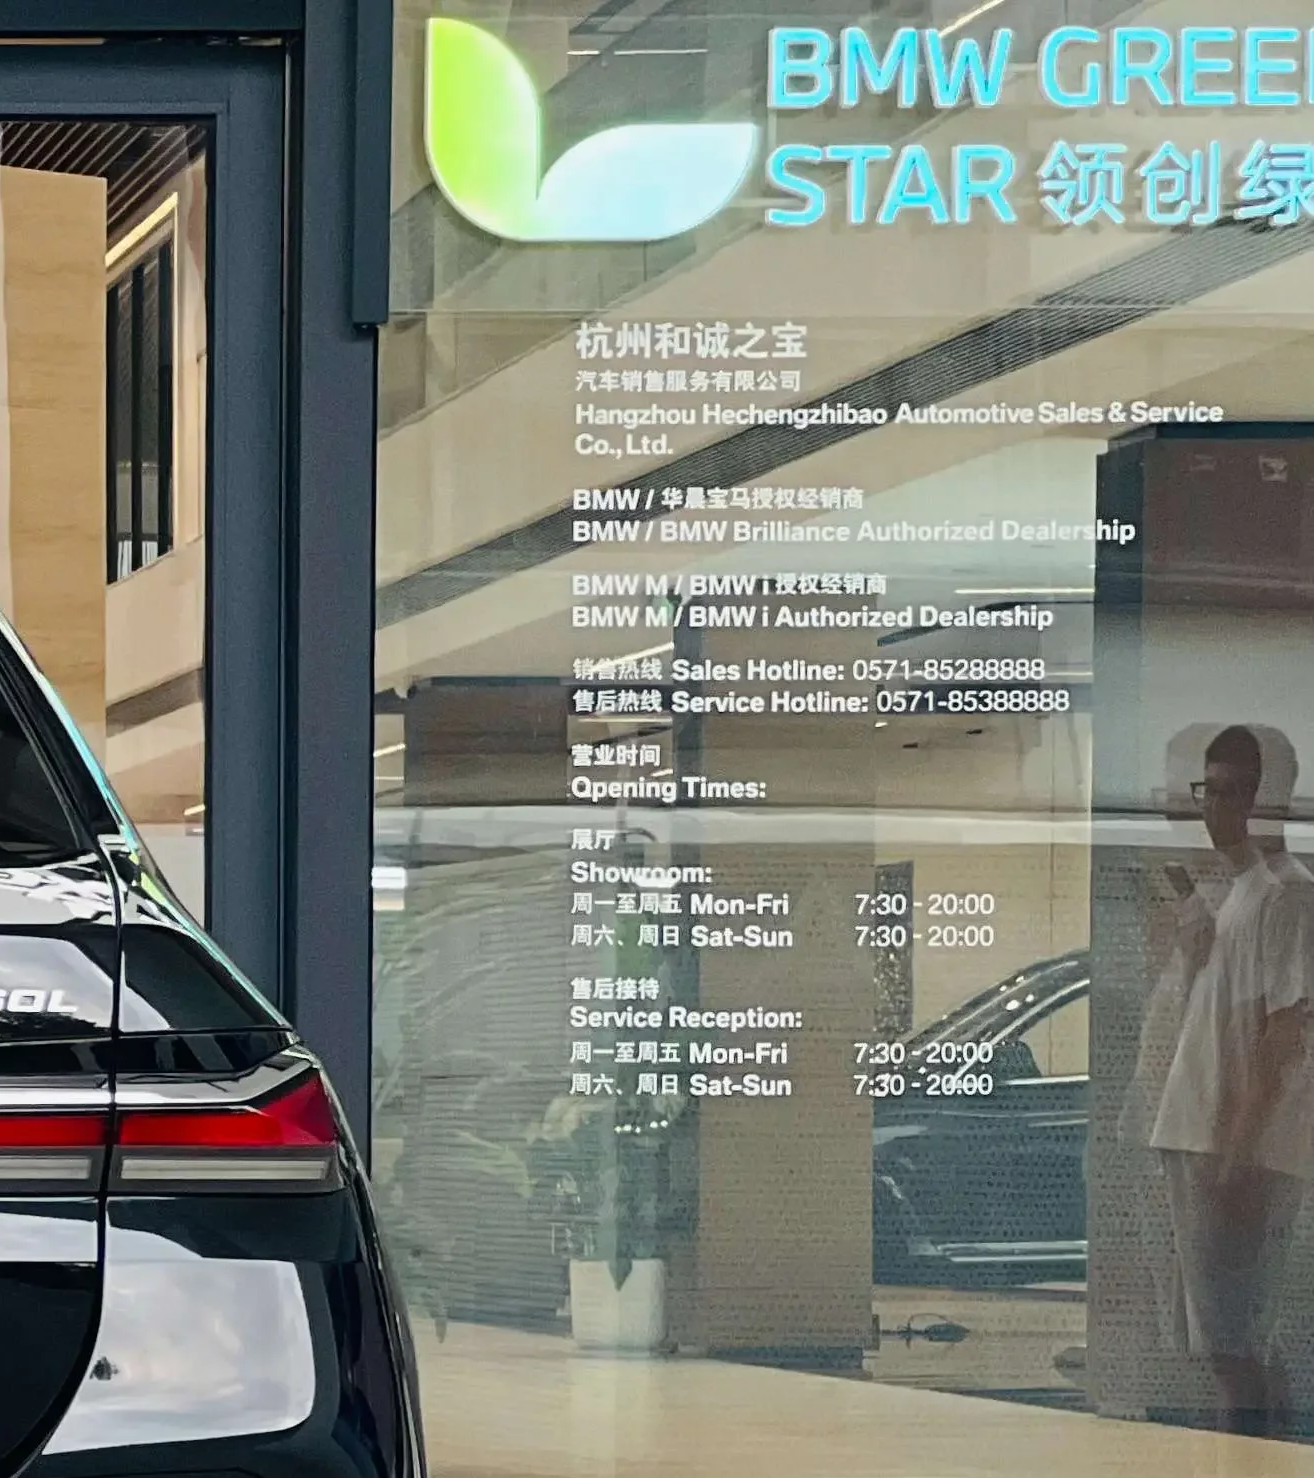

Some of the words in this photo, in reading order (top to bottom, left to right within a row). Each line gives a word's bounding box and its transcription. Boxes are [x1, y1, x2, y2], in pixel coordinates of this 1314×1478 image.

[766, 26, 1012, 108] BMW
[1040, 25, 1314, 108] GREE
[765, 143, 1017, 226] STAR
[1038, 138, 1314, 227] 领创绿
[576, 321, 807, 359] 杭州和诚之宝
[576, 370, 800, 392] 汽车销售服务有限公司
[576, 403, 695, 429] Hangzhou
[703, 403, 888, 429] Hechengzhibao
[895, 402, 1034, 424] Automotive
[1038, 401, 1103, 424] Sales
[1108, 401, 1126, 424] &
[1131, 401, 1223, 424] Service
[573, 489, 640, 510] BMW
[661, 487, 863, 510] 华晨宝马授权经销商
[573, 520, 639, 542] BMW
[660, 520, 727, 542] BMW
[733, 520, 850, 542] Brilliance
[857, 519, 994, 542] Authorized
[1002, 519, 1136, 544] Dealership
[572, 574, 639, 595] BMW
[646, 574, 667, 595] M
[689, 574, 756, 595] BMW
[762, 573, 769, 595] i
[775, 572, 887, 595] 授权经销商
[572, 605, 639, 627] BMW
[645, 605, 667, 627] M
[689, 605, 756, 627] BMW
[762, 605, 769, 627] i
[775, 605, 913, 628] Authorized
[920, 605, 1053, 631] Dealership
[573, 658, 662, 681] 销售热线
[672, 659, 740, 681] Sales
[747, 659, 845, 681] Hotline:
[852, 659, 1045, 681] 0571-85288888
[573, 689, 662, 713] 售后热线
[672, 690, 764, 713] Service
[771, 690, 868, 713] Hotline:
[876, 690, 1070, 713] 0571-85388888
[571, 744, 661, 767] 营业时间
[571, 776, 676, 803] Opening
[681, 776, 767, 798] Times:
[571, 828, 615, 850] 展厅
[571, 861, 712, 883] Showroom:
[571, 893, 682, 914] 周一至周五
[690, 893, 789, 915] Mon-Fri
[855, 893, 907, 915] 7:30
[927, 893, 995, 915] 20:00
[571, 924, 679, 947] 周六、周日
[691, 925, 793, 947] Sat-Sun
[855, 926, 907, 947] 7:30
[927, 926, 995, 947] 20:00
[571, 977, 660, 1000] 售后接待
[570, 1006, 662, 1028] Service
[668, 1006, 802, 1032] Reception:
[570, 1041, 681, 1063] 周一至周五
[689, 1042, 788, 1064] Mon-Fri
[854, 1042, 906, 1064] 7:30
[926, 1042, 994, 1064] 20:00
[570, 1073, 678, 1095] 周六、周日
[689, 1074, 791, 1096] Sat-Sun
[854, 1074, 906, 1096] 7:30
[926, 1074, 994, 1096] 20:00
